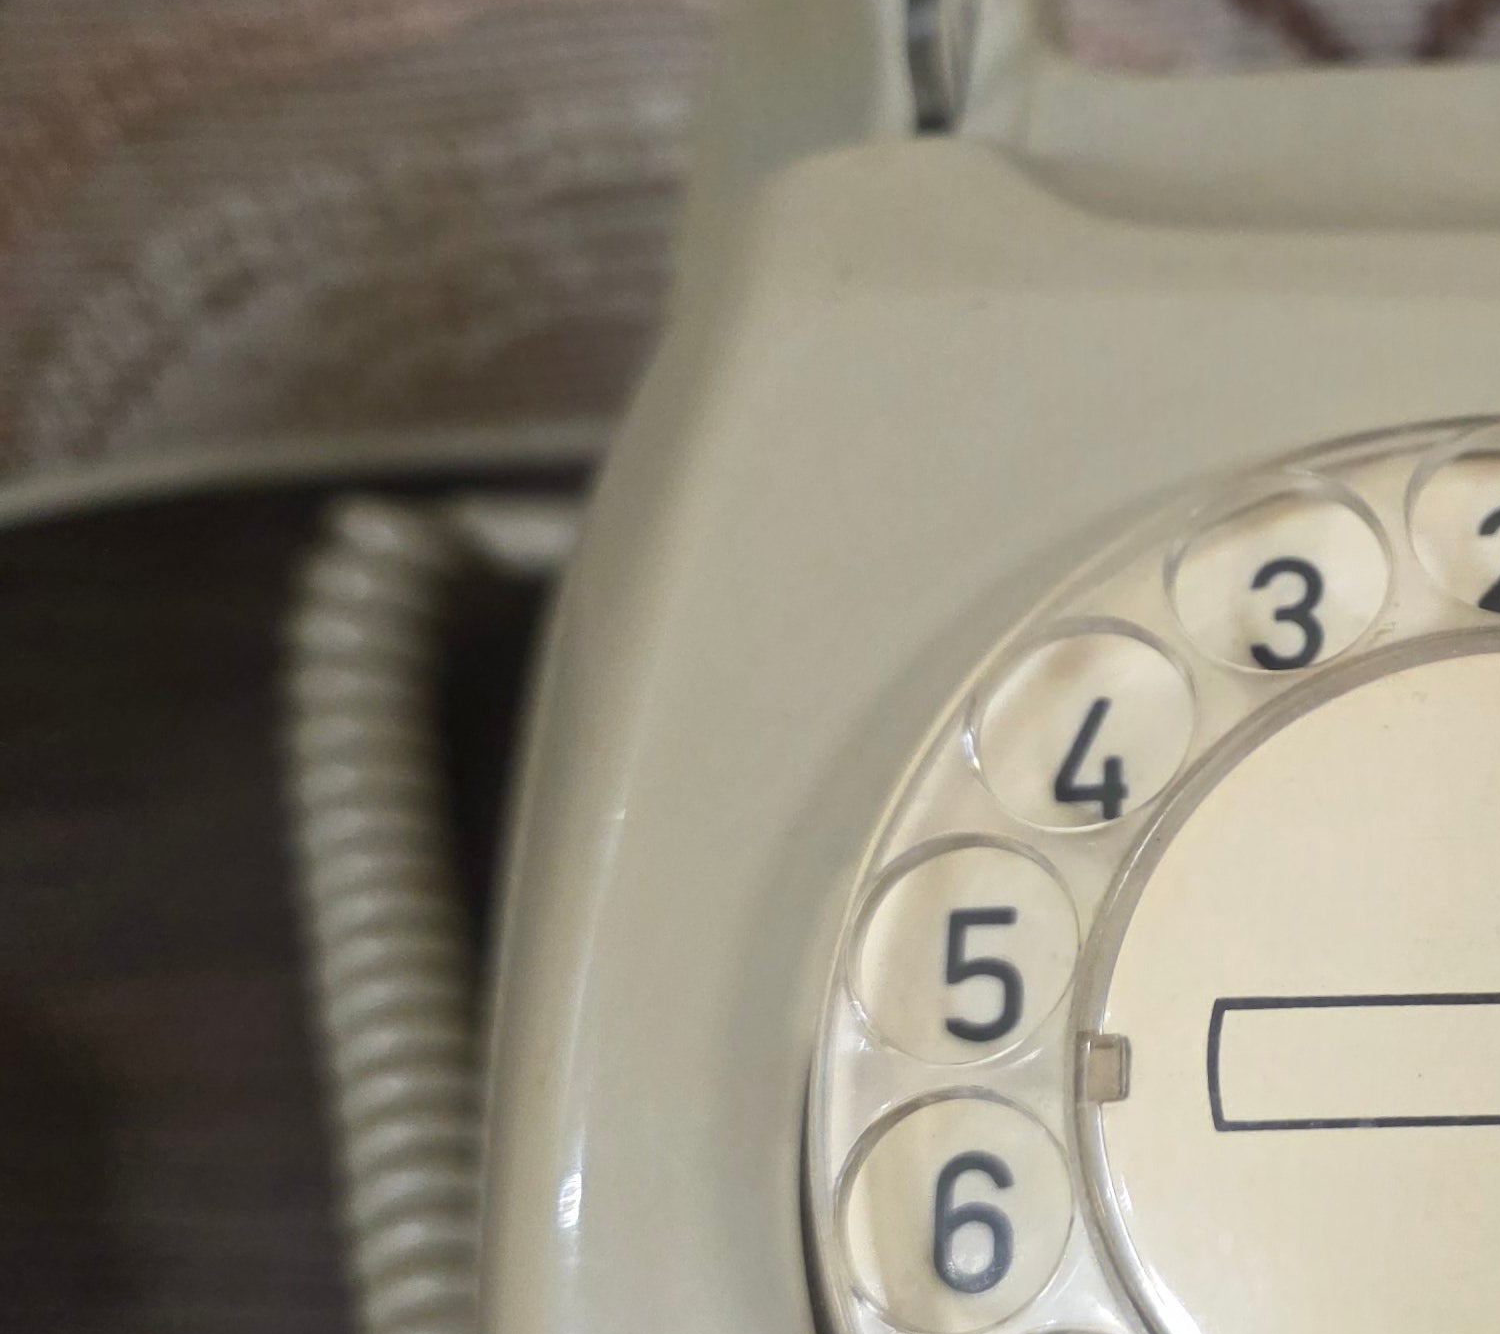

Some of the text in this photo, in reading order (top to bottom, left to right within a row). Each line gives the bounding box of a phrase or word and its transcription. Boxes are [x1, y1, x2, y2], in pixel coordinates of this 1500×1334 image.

[1249, 557, 1326, 672] 3
[1053, 697, 1128, 821] 4
[944, 906, 1023, 1043] 5
[932, 1150, 1015, 1294] 6
